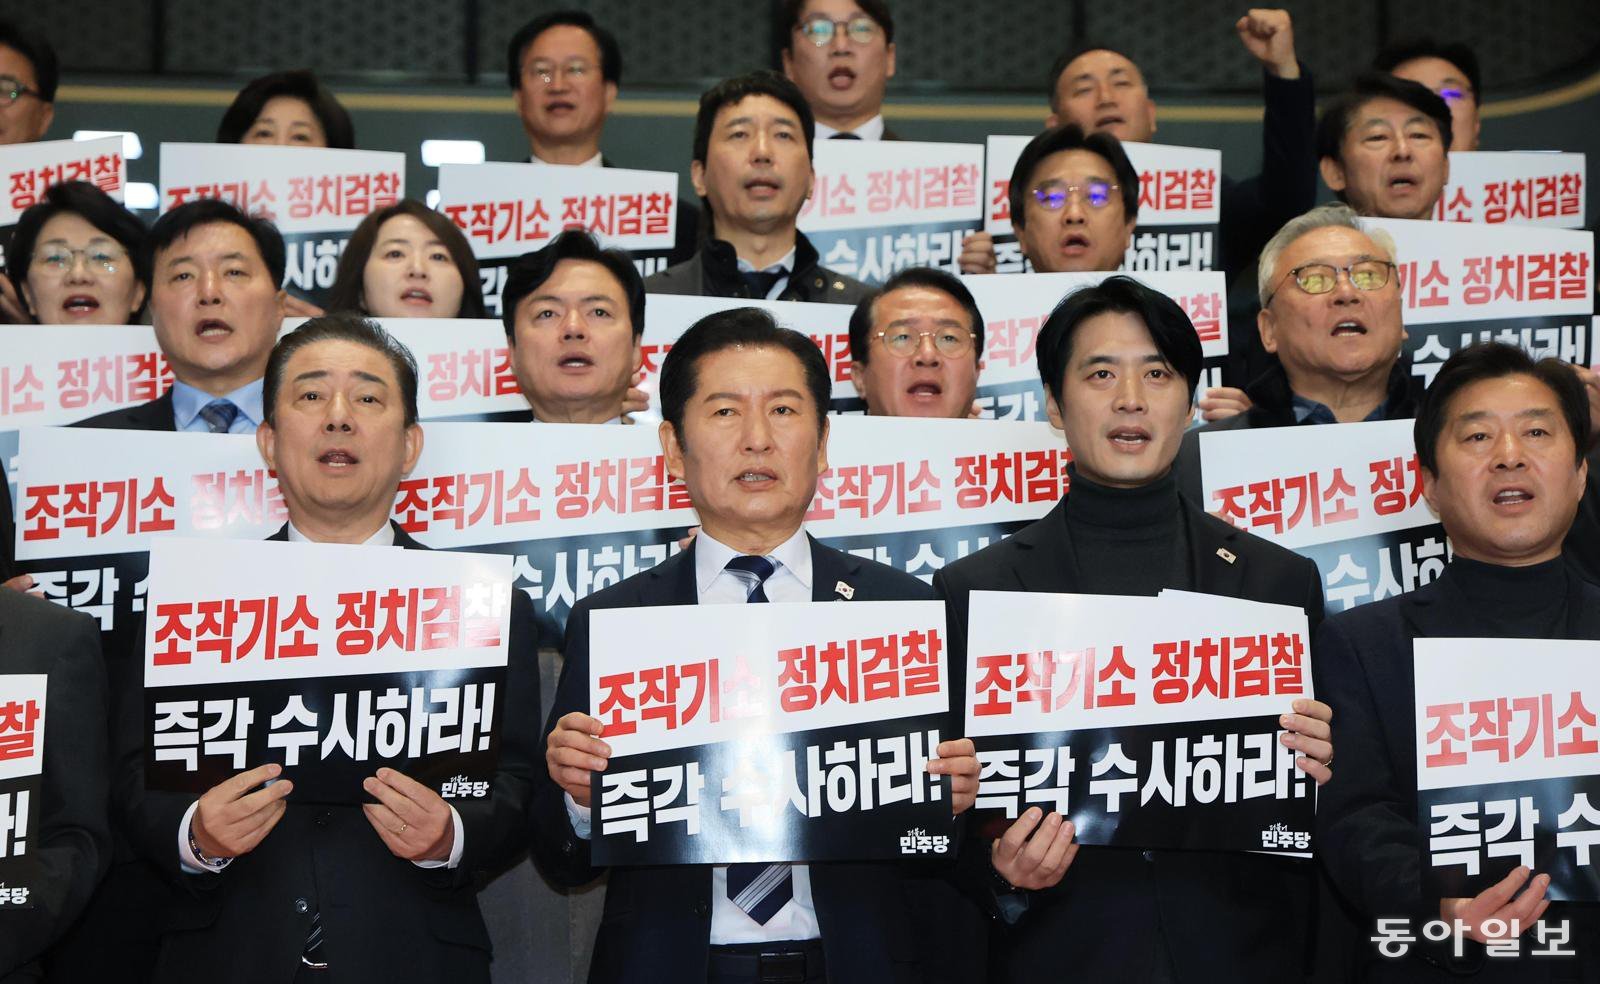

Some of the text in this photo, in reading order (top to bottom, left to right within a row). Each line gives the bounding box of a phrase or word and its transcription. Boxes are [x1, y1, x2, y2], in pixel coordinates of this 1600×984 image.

[561, 193, 672, 236] 정치검찰
[867, 163, 979, 214] 정치검찰
[1484, 173, 1581, 224] 정치검찰
[1462, 252, 1590, 305] 정치검찰
[24, 477, 175, 541] 조작기소
[395, 468, 541, 534] 조작기소
[153, 594, 319, 666] 조작기소
[336, 586, 509, 656] 정치검찰
[599, 629, 942, 738] 조작기소 정치검찰
[974, 632, 1304, 716] 조작기소 정치검찰
[154, 682, 496, 772] 즉각 수사하라!
[1425, 691, 1599, 768] 조작기소
[441, 781, 489, 797] 민주당
[601, 729, 942, 843] 즉각 수사하라!
[974, 730, 1306, 819] 즉각 수사하라!
[900, 835, 950, 853] 민주당
[1261, 831, 1311, 849] 민주당
[1429, 796, 1539, 876] 즉각
